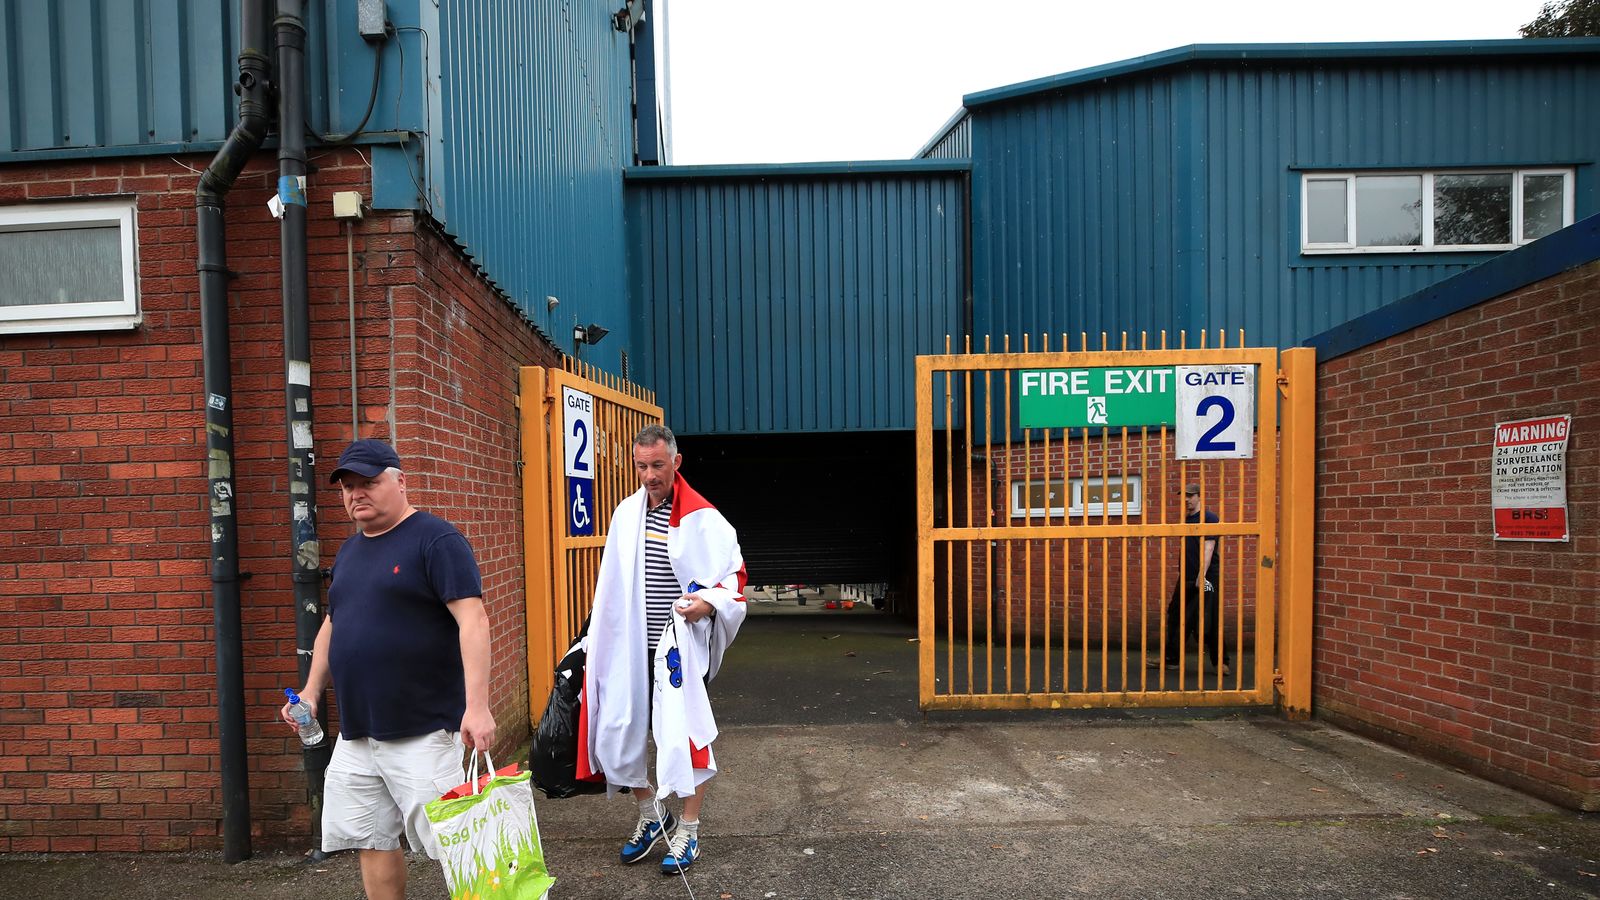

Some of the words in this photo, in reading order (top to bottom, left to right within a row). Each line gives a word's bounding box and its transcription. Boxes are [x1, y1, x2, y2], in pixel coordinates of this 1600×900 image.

[1022, 371, 1090, 396] FIRE
[1105, 369, 1172, 394] EXIT
[1185, 372, 1245, 386] GATE
[567, 394, 591, 413] GATE
[1195, 395, 1236, 452] 2
[1498, 421, 1566, 443] WARNING
[573, 418, 589, 472] 2
[1497, 448, 1508, 456] 24
[1512, 445, 1538, 454] HOUR
[1541, 442, 1564, 452] CCTV
[1496, 453, 1562, 466] SURVEILLANCE
[1496, 468, 1507, 476] IN
[1511, 464, 1562, 475] OPERATION
[437, 826, 470, 847] bag
[473, 817, 488, 833] fr
